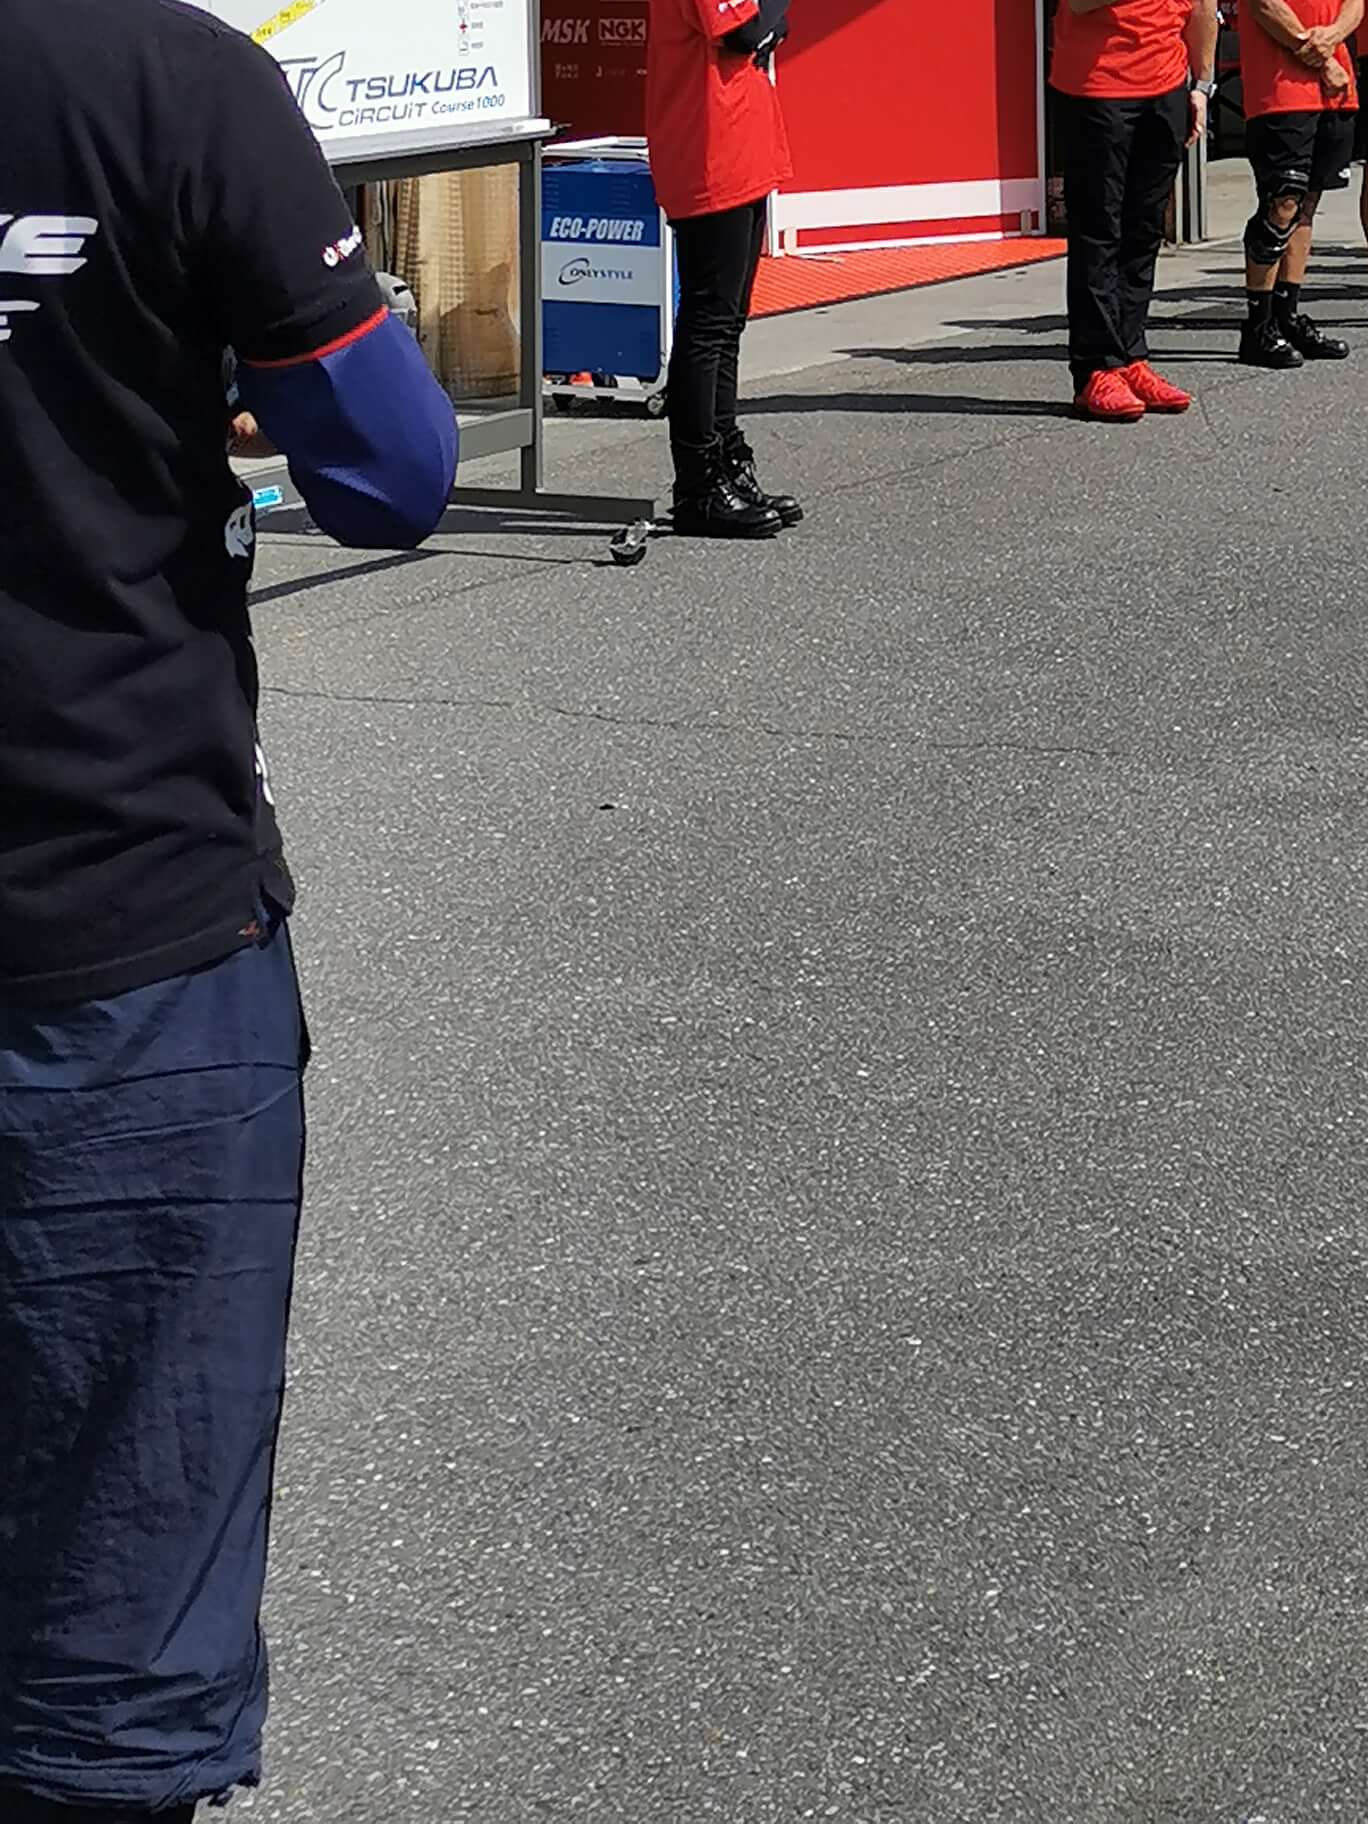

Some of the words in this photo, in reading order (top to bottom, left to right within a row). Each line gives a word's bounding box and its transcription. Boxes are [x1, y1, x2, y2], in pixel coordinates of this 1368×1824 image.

[541, 18, 591, 44] MSK
[600, 19, 646, 41] NGK
[346, 66, 499, 103] TSUKUBA
[431, 100, 474, 115] Course
[476, 94, 505, 110] 1000
[549, 216, 645, 242] ECO-POWER
